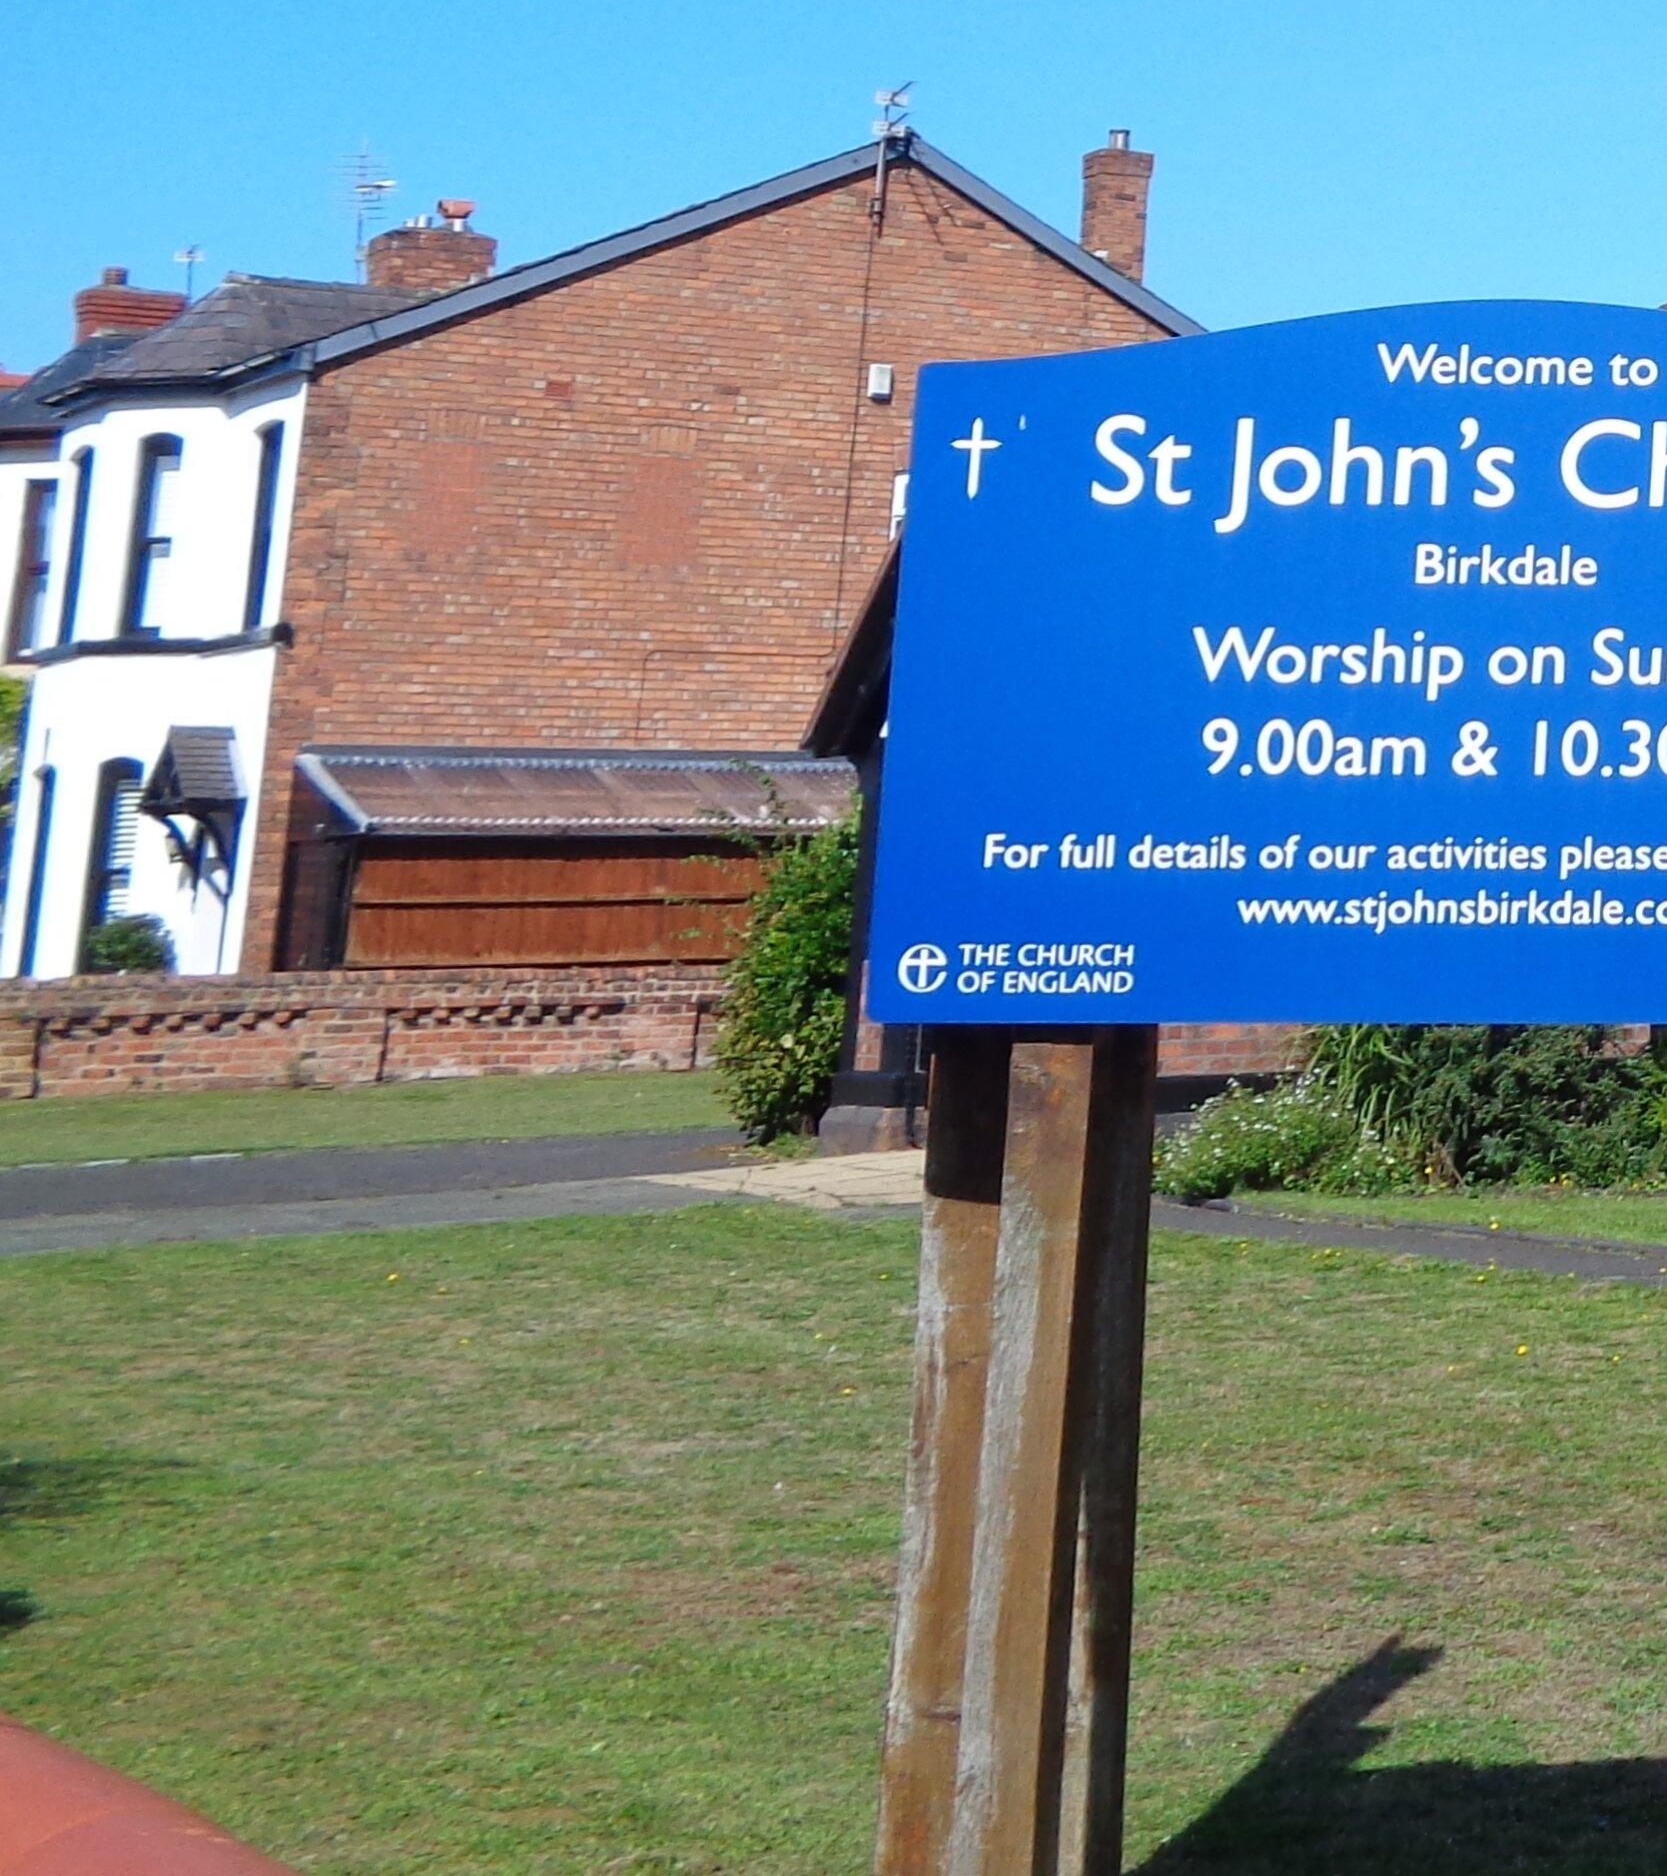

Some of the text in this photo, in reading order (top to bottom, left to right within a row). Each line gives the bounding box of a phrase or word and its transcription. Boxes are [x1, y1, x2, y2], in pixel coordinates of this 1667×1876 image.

[1378, 344, 1658, 386] Welcome to
[1091, 414, 1191, 505] St
[1215, 418, 1514, 533] John's
[1415, 544, 1597, 586] Birkdale
[1193, 627, 1463, 701] Worship
[1489, 646, 1565, 685] on
[1203, 717, 1426, 776] 9.00am
[1452, 721, 1497, 776] &
[984, 834, 1048, 868] For
[1060, 834, 1115, 868] full
[1129, 835, 1245, 869] details
[1260, 835, 1300, 869] of
[1309, 846, 1376, 869] our
[1388, 838, 1546, 869] activities
[959, 944, 1133, 966] THE CHURCH
[958, 971, 1133, 993] OF ENGLAND
